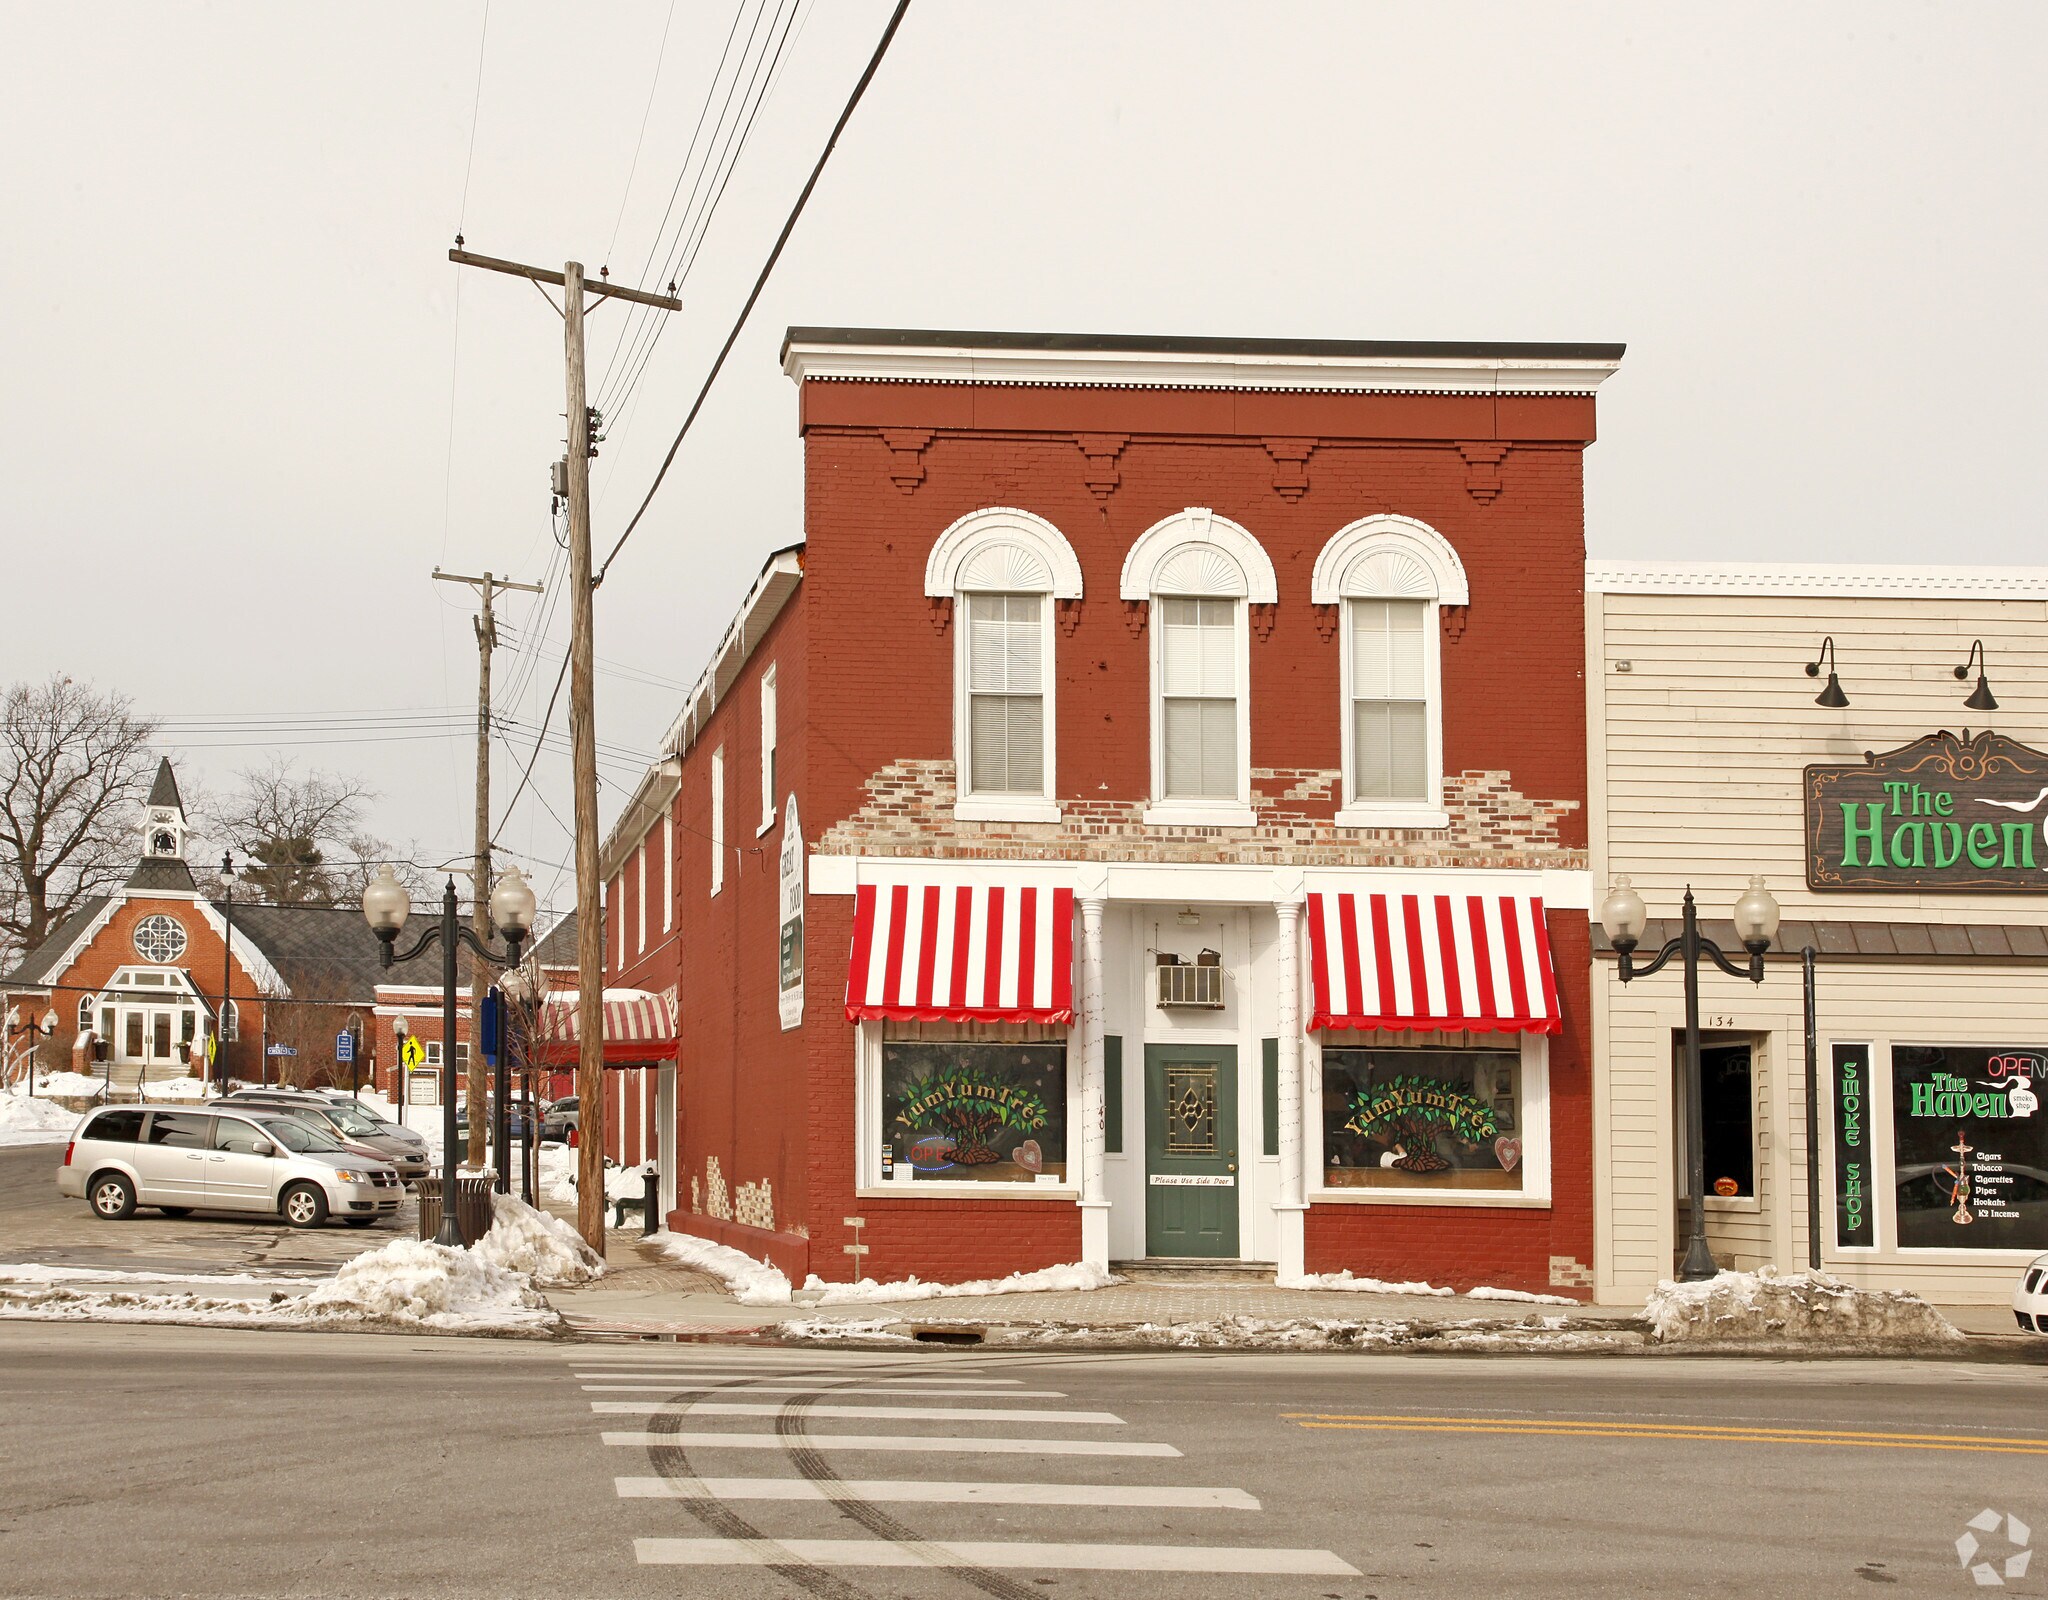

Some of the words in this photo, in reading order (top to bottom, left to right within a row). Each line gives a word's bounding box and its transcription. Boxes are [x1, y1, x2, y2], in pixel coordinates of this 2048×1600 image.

[1883, 782, 1954, 817] The
[1839, 803, 2037, 869] Haven
[1709, 1016, 1734, 1027] 134
[1988, 1056, 2046, 1079] OPEN
[1932, 1073, 1968, 1092] The
[1842, 1062, 1861, 1146] SMOKE
[1910, 1083, 2009, 1118] Haven
[2016, 1102, 2031, 1110] shop
[911, 1145, 957, 1162] OPE
[1976, 1152, 2002, 1161] Cigars
[1972, 1163, 2003, 1172] Tobacco
[1154, 1176, 1178, 1184] Please
[1196, 1177, 1210, 1185] Side
[1975, 1175, 2014, 1184] Cigarettes
[1975, 1187, 1997, 1195] Pipes
[1846, 1163, 1862, 1231] SHOP
[1973, 1198, 2006, 1206] Hookahs
[1978, 1209, 1989, 1217] K2
[1990, 1209, 2020, 1218] Incense
